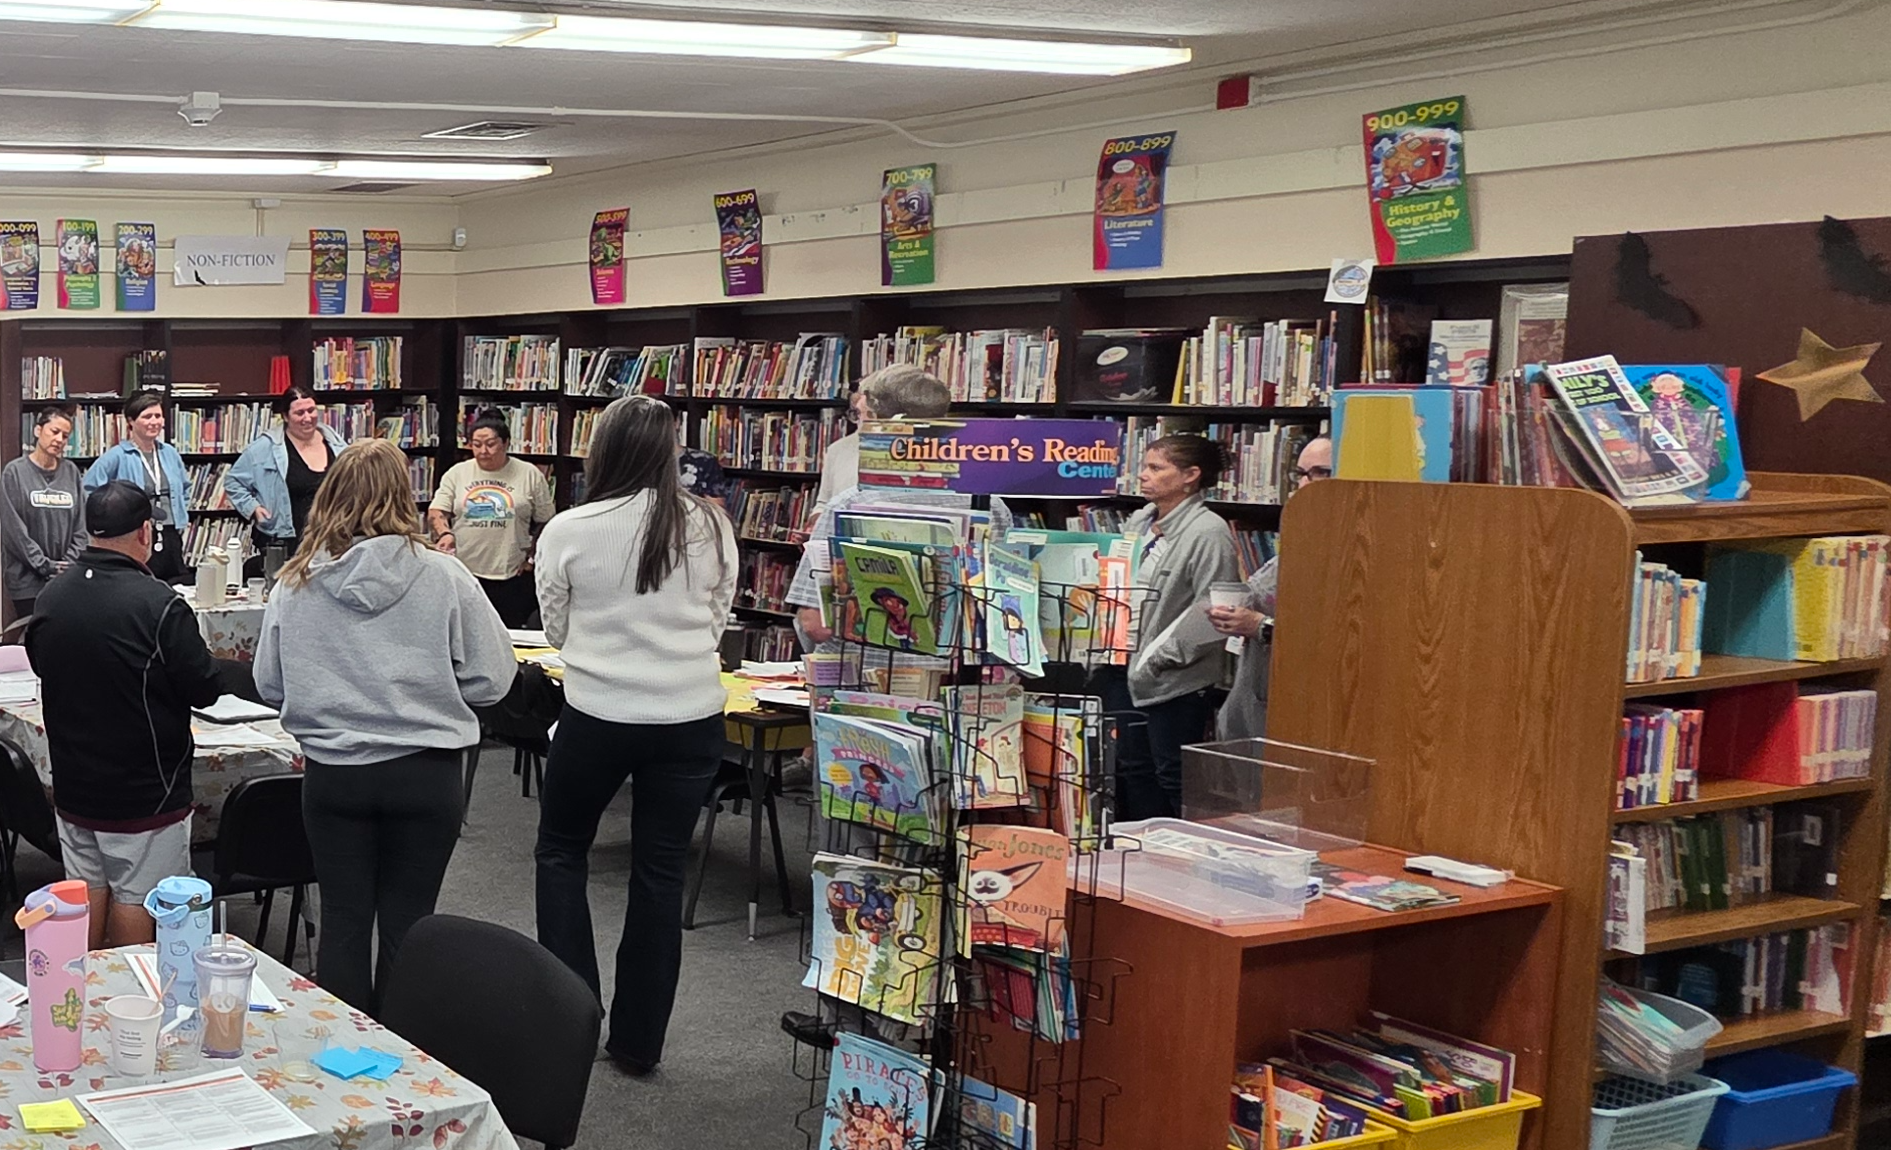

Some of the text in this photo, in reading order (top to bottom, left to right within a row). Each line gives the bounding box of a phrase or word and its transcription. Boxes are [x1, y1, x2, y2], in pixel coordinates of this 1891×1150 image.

[1367, 101, 1460, 132] 900-999
[1104, 136, 1171, 155] 800-899
[886, 167, 933, 184] 700-799
[716, 193, 755, 208] 600-699
[1389, 195, 1455, 216] History &
[1104, 219, 1154, 230] Literature
[1387, 207, 1460, 227] Geography
[62, 222, 95, 232] 100-199
[118, 225, 153, 235] 200-299
[312, 231, 346, 242] 300-399
[365, 231, 399, 241] 400-499
[187, 253, 277, 268] NON-FICTION
[891, 438, 1035, 462] Children's
[1058, 461, 1117, 479] Cente
[1003, 833, 1065, 861] Jones
